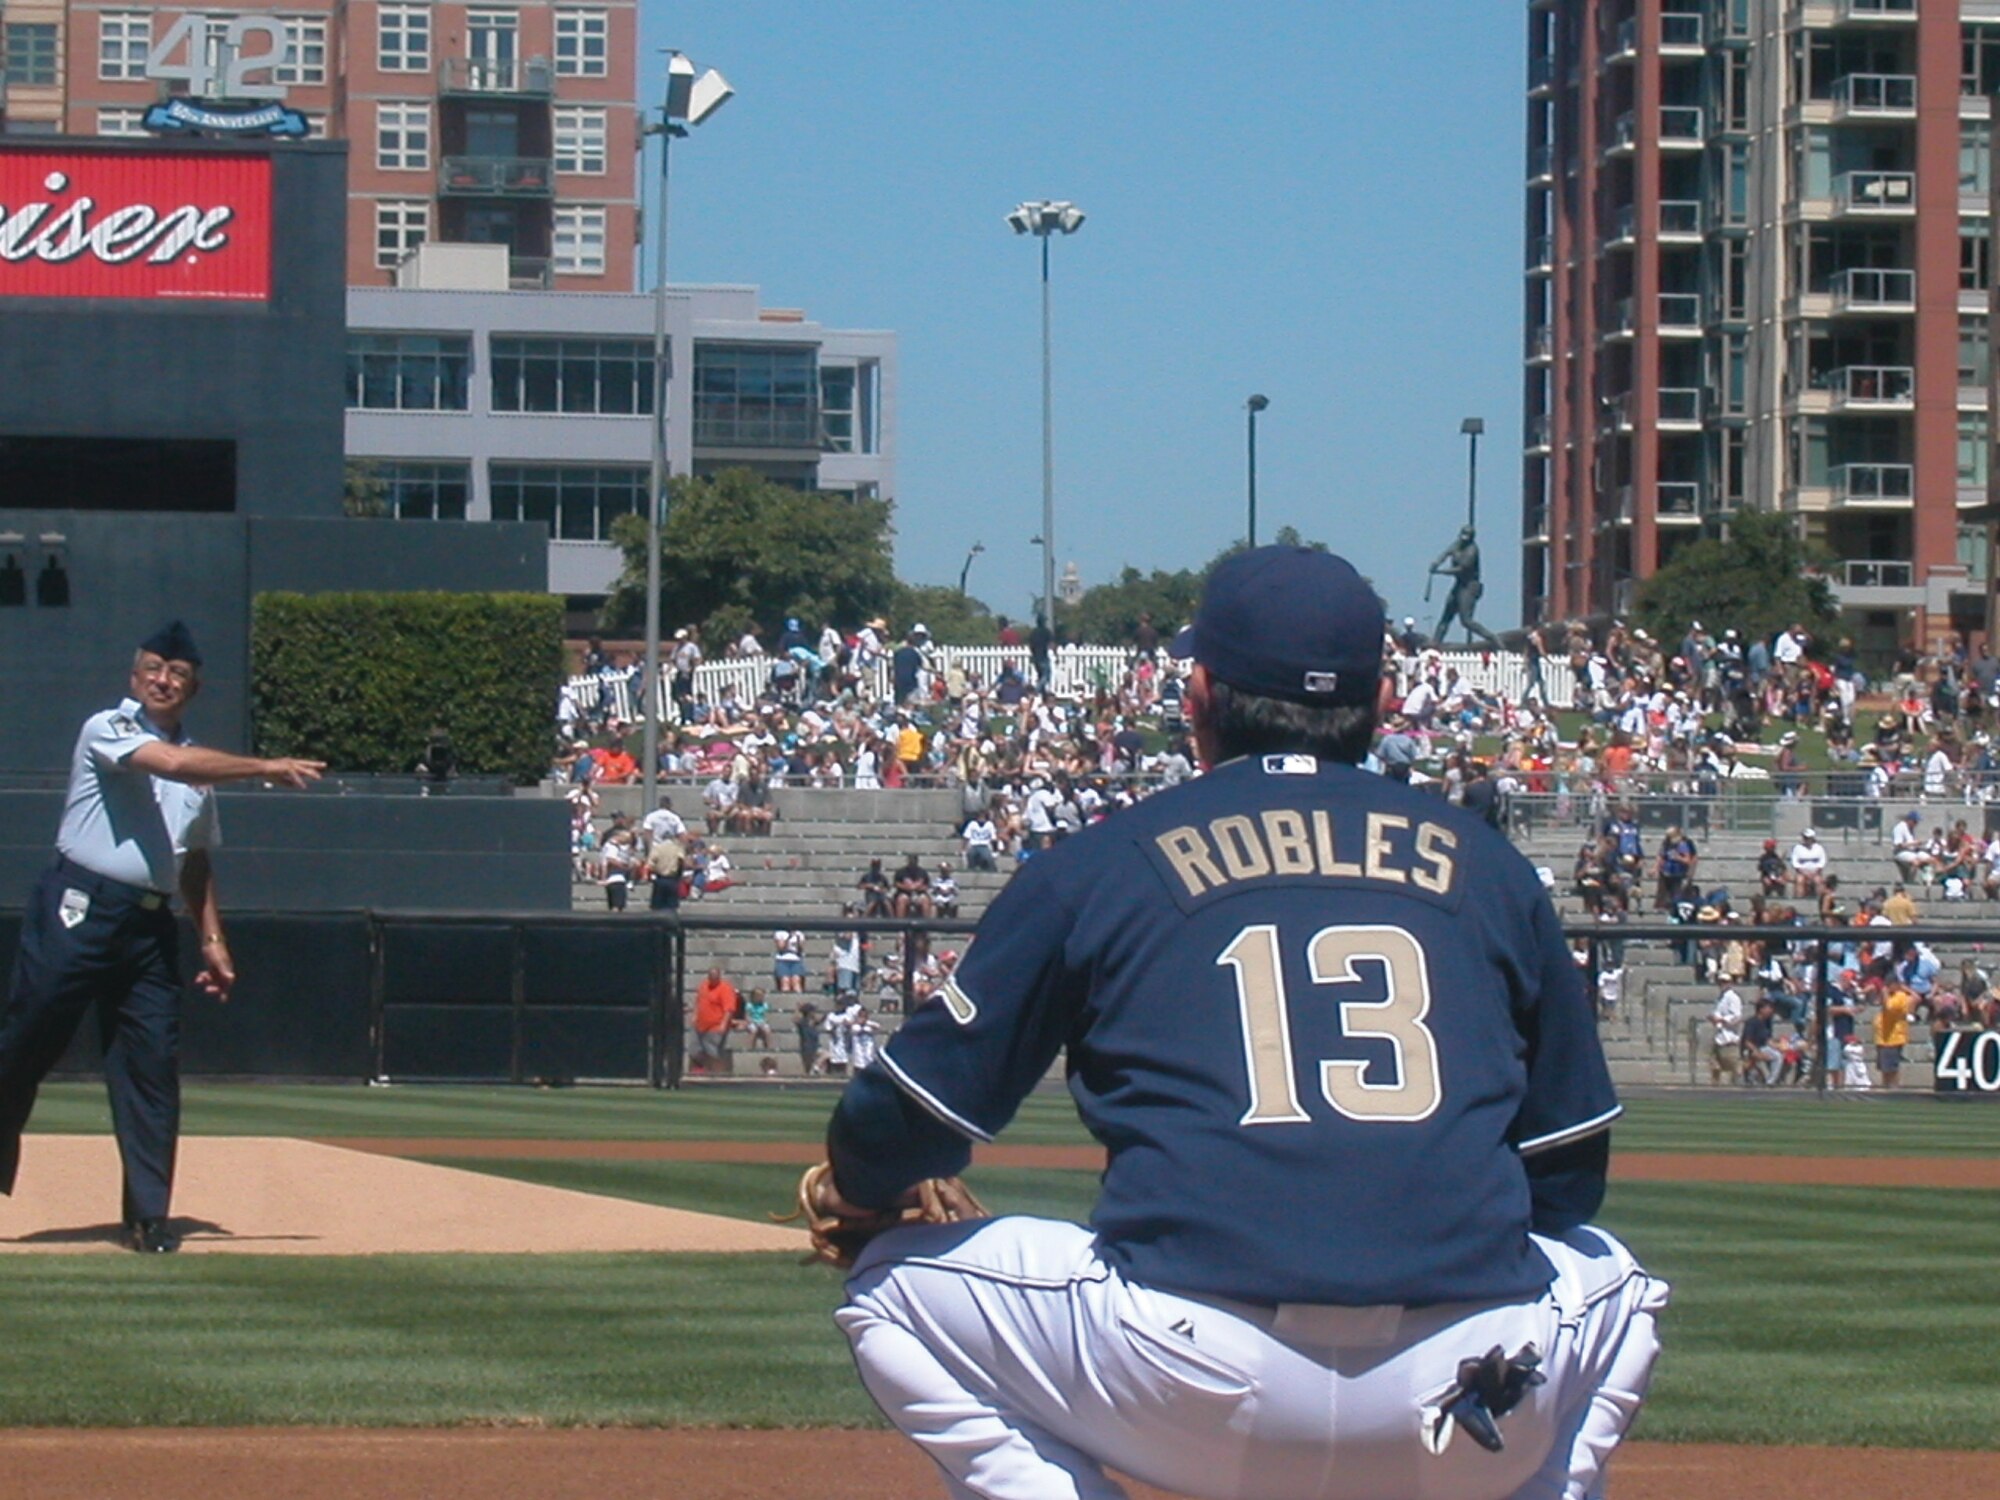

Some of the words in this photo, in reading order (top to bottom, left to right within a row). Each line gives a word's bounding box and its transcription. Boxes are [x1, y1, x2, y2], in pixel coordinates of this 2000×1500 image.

[146, 14, 288, 98] 42
[0, 171, 233, 263] iser
[1155, 810, 1458, 897] ROBLES
[1216, 924, 1442, 1126] 13
